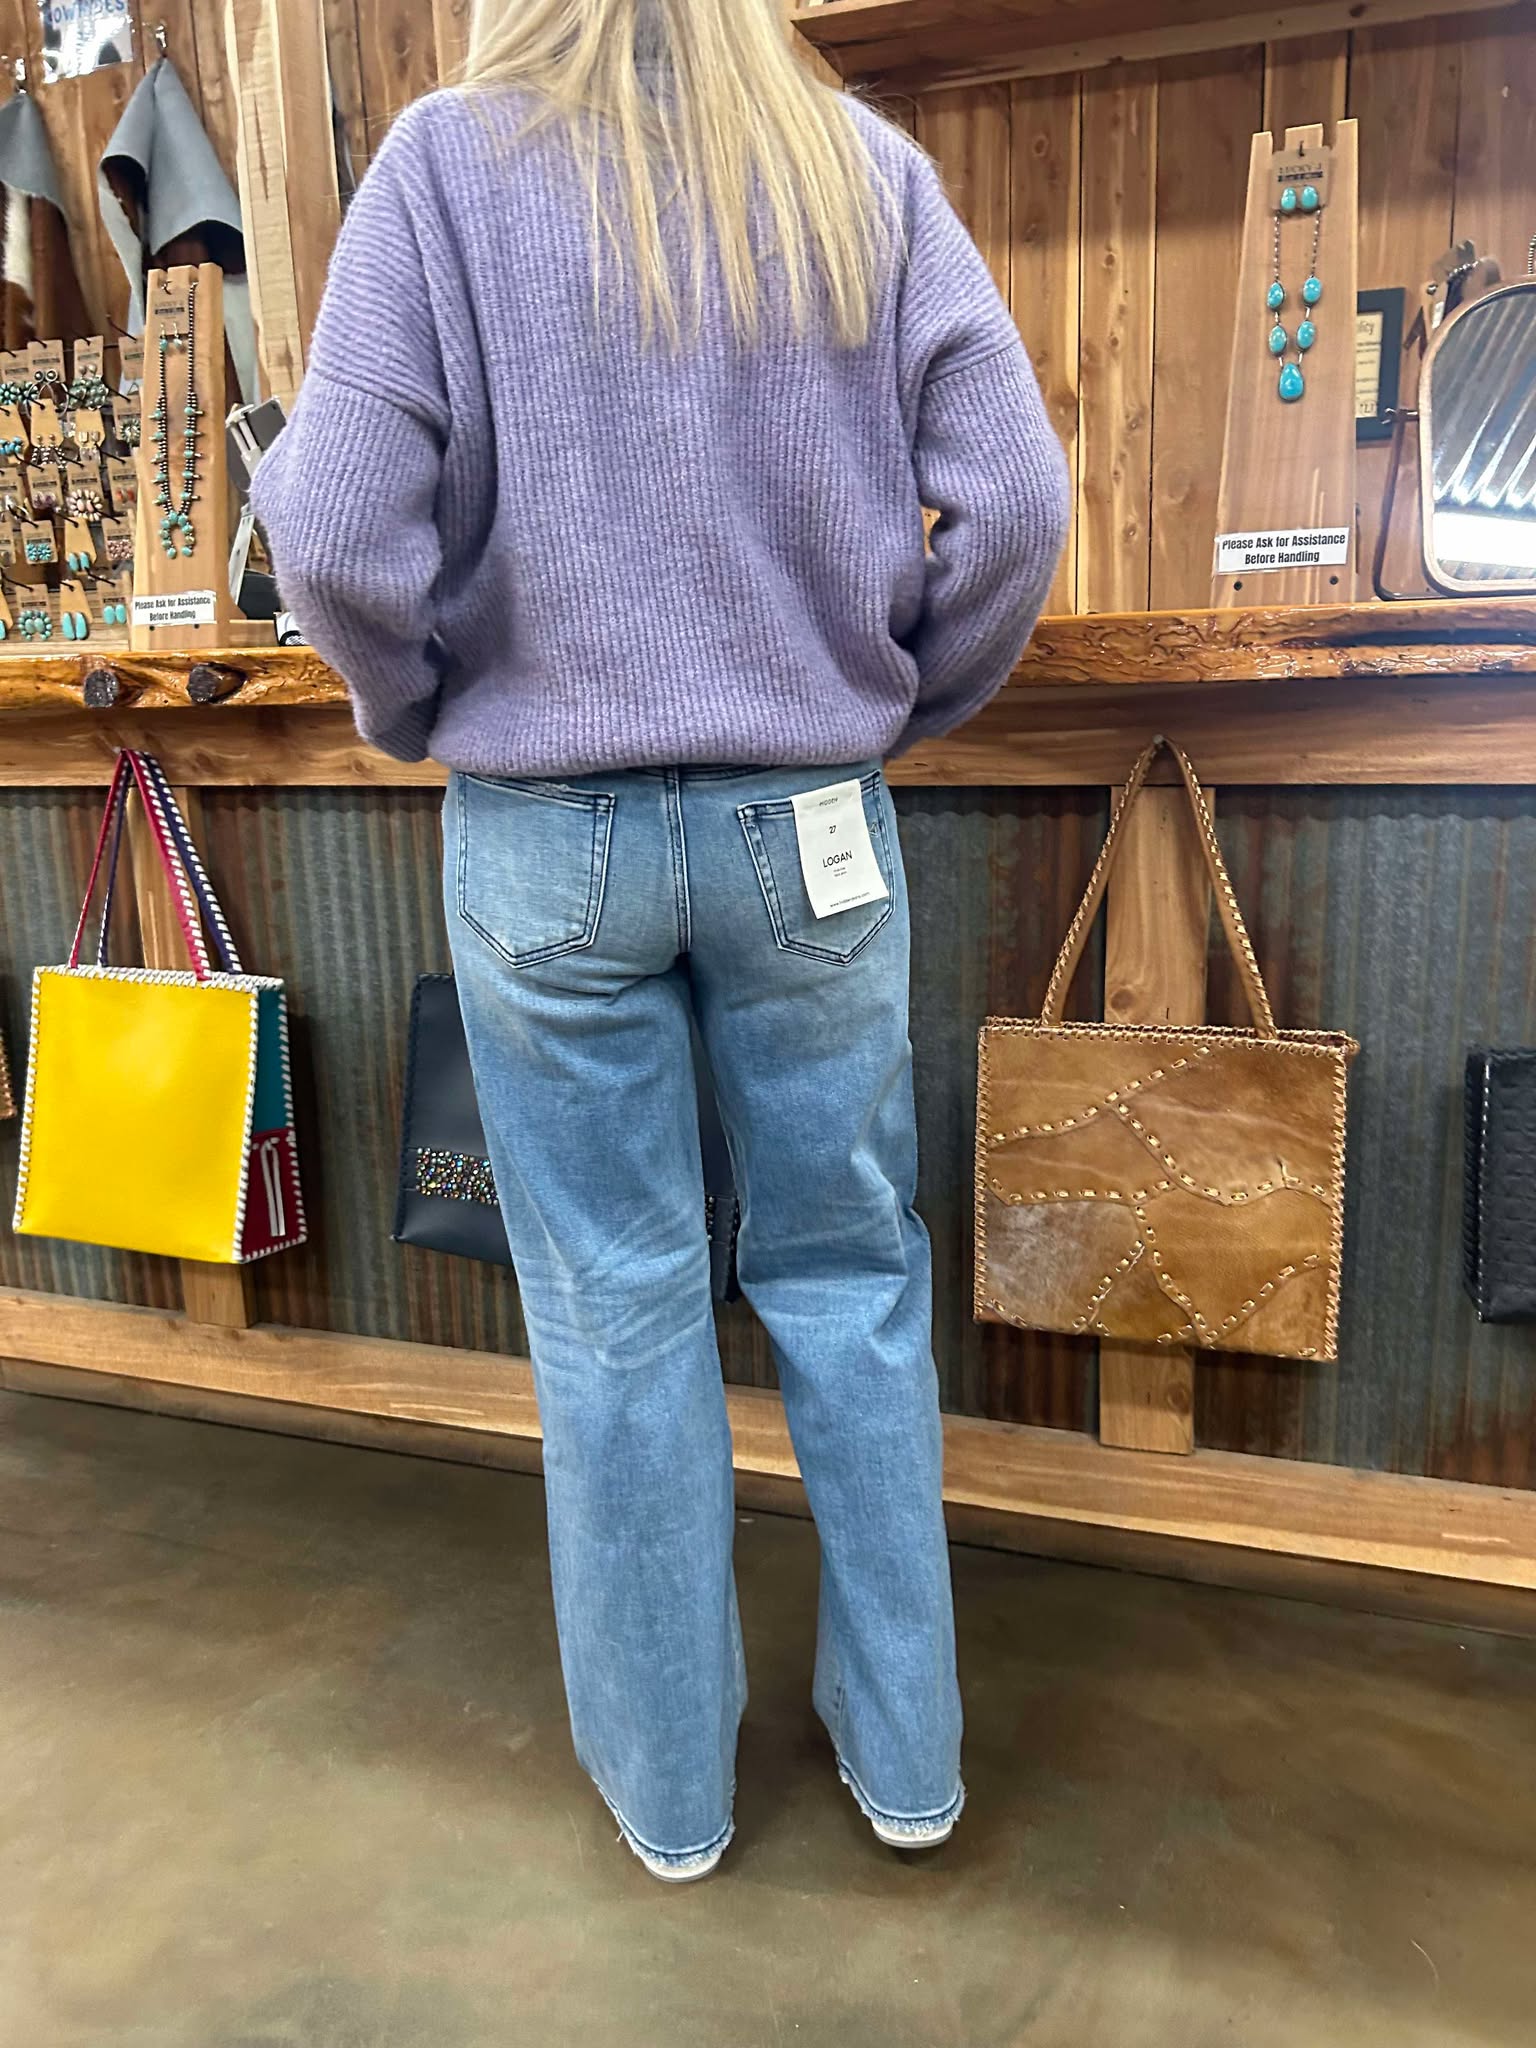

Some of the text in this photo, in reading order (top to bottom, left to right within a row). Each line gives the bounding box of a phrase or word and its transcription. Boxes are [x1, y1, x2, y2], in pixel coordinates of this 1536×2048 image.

[1222, 534, 1346, 550] Please Ask for Assistance
[1244, 551, 1320, 564] Before Handling
[135, 597, 211, 610] Please Ask for Assistance
[149, 610, 196, 621] Before Handling
[829, 825, 837, 834] 27
[822, 850, 853, 868] LOGAN
